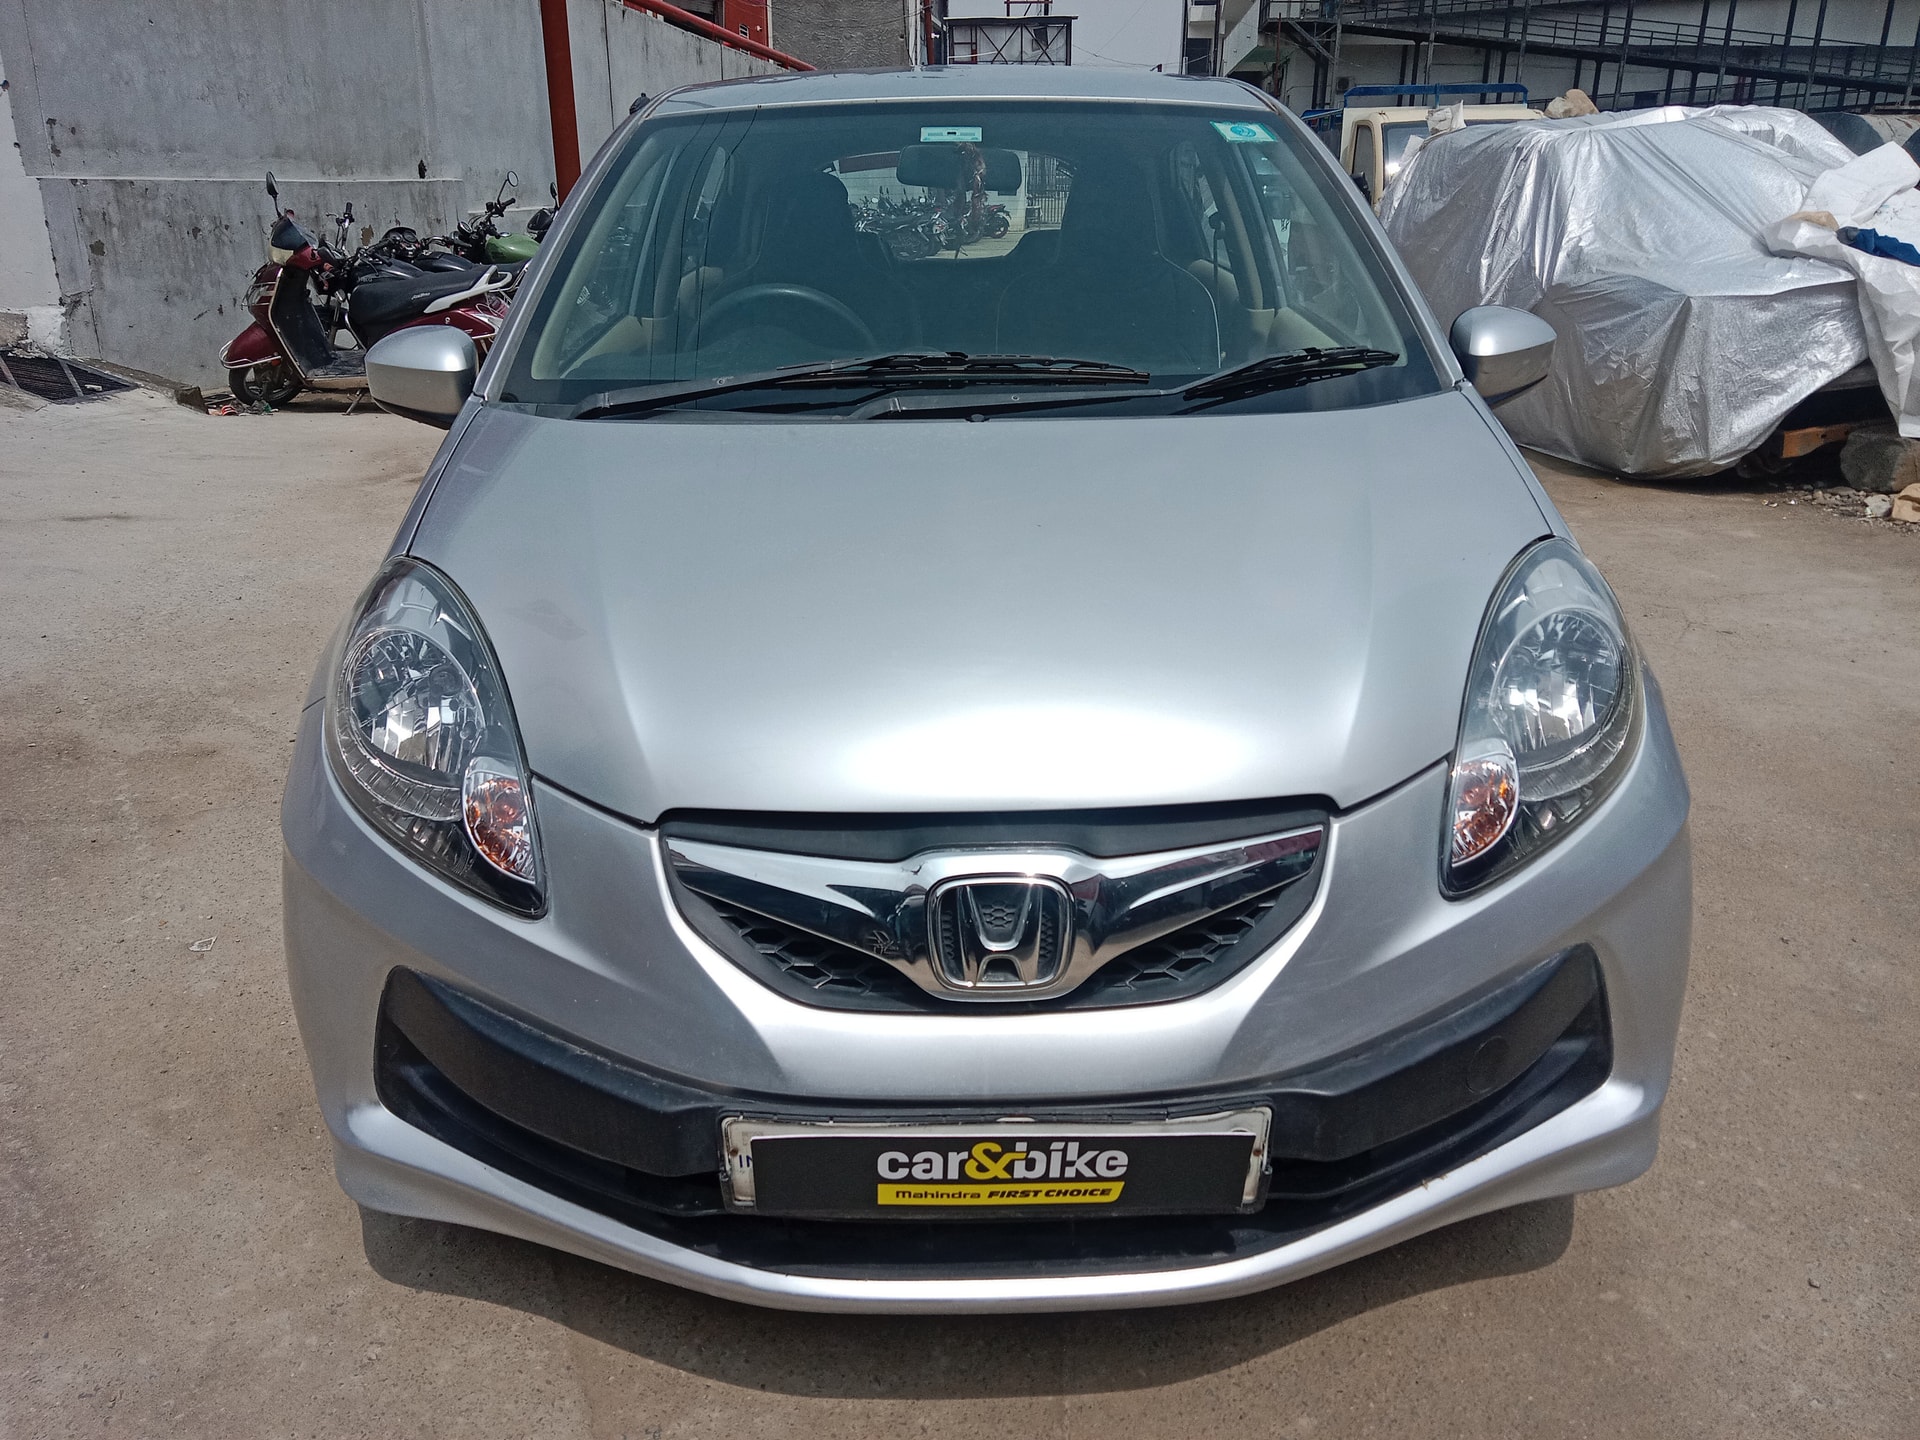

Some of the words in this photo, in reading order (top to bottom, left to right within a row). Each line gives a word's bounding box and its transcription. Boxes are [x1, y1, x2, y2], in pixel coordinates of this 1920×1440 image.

[877, 1141, 1129, 1180] car&bike
[895, 1190, 981, 1199] Mahindra
[987, 1189, 1043, 1198] FIRST
[1044, 1188, 1112, 1198] CHOICE
